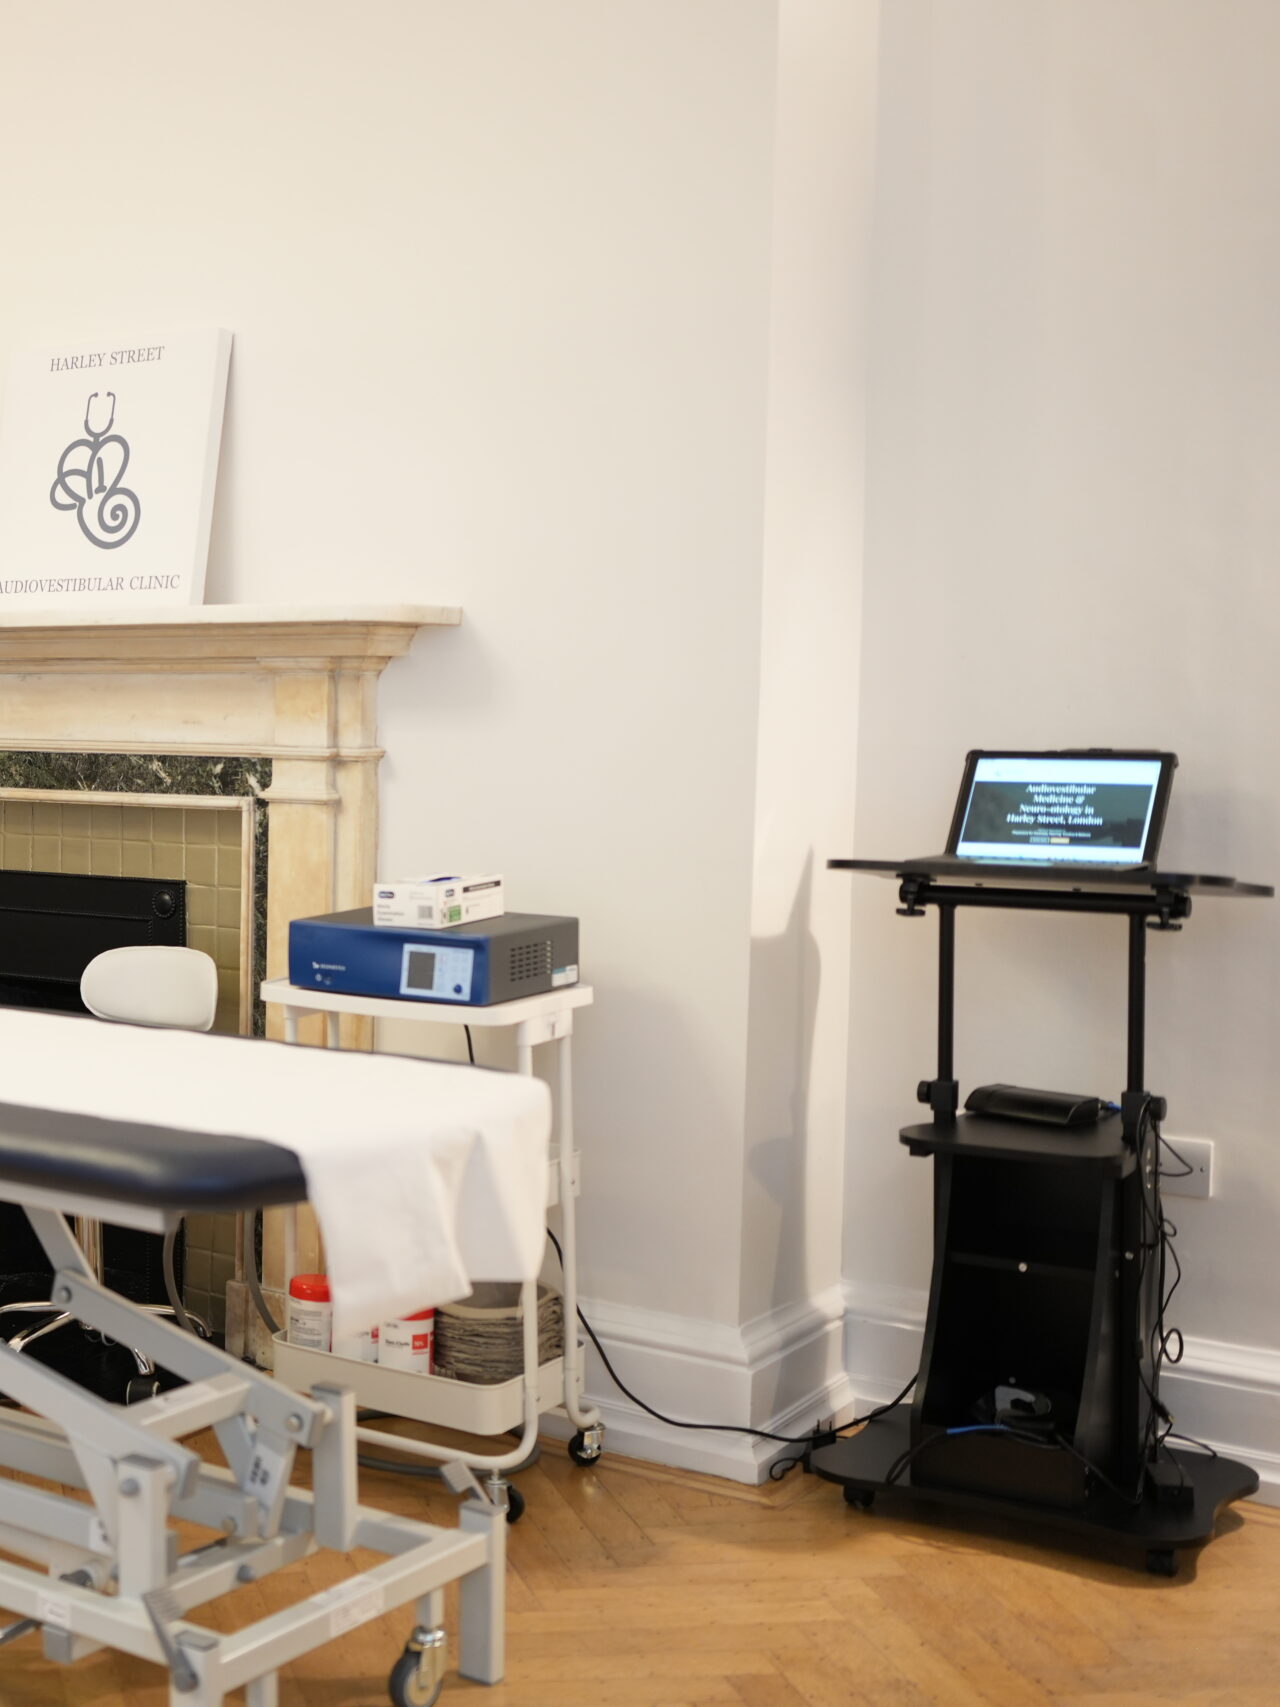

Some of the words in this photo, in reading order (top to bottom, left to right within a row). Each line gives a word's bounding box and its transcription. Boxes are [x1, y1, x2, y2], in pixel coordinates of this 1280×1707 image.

[49, 352, 107, 372] HARLEY
[109, 345, 166, 366] STREET
[129, 574, 181, 591] CLINIC
[1006, 813, 1036, 824] Harley
[1068, 815, 1103, 826] London
